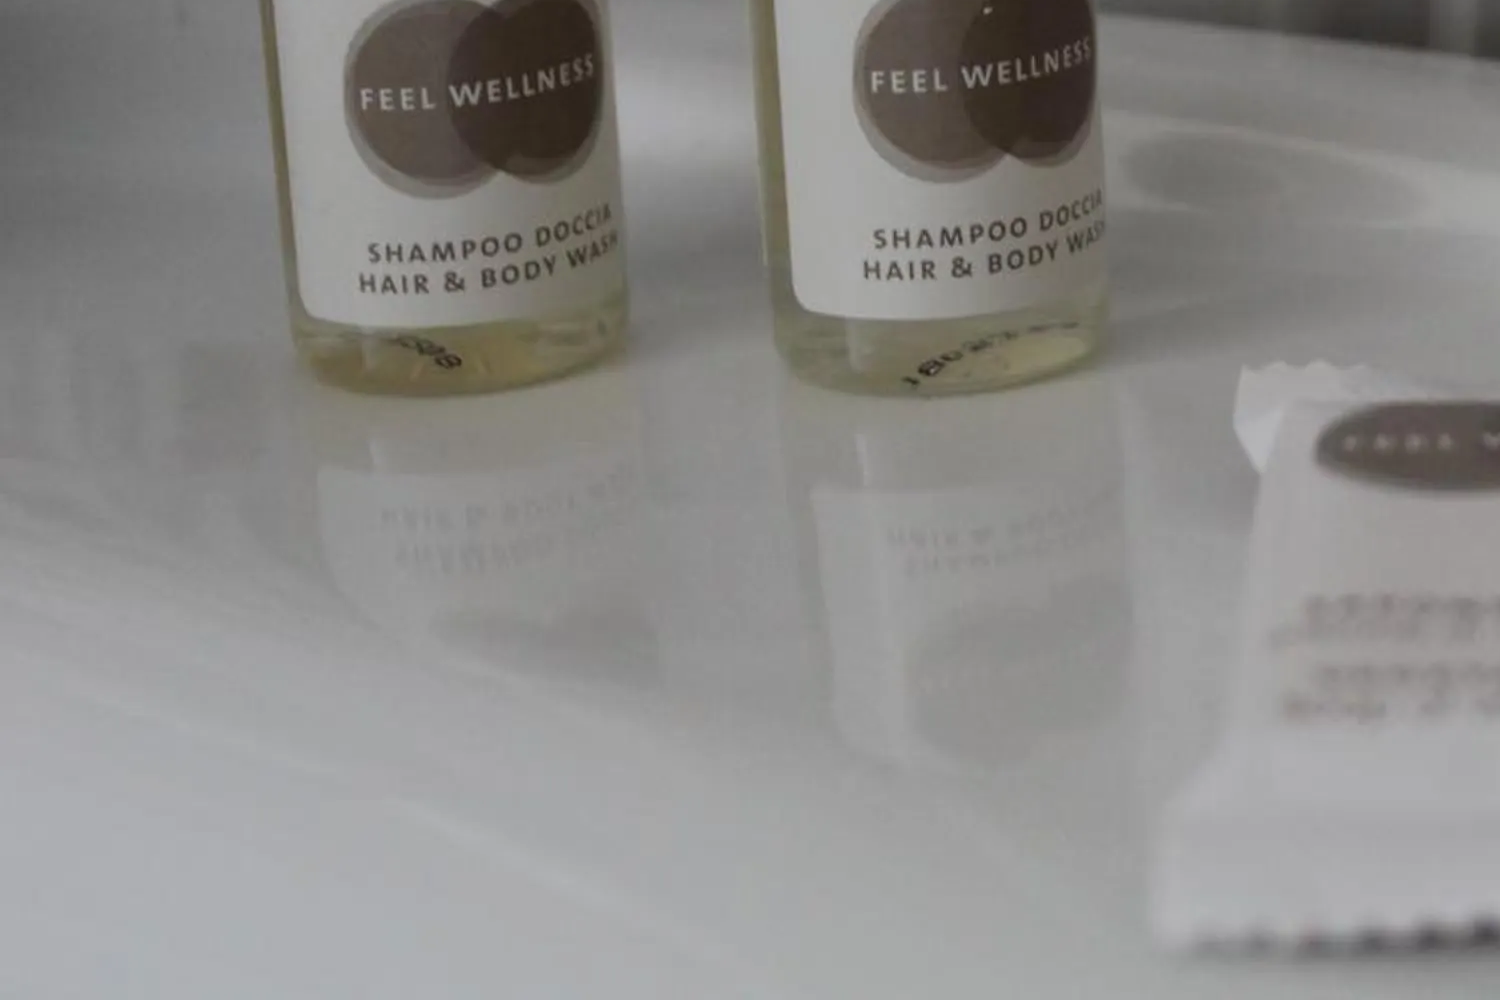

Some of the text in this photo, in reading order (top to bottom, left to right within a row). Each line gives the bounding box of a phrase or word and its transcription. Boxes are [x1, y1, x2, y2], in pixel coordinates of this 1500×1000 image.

[360, 53, 594, 111] FEEL WELLNESS
[869, 36, 1091, 94] FEEL WELLNESS
[367, 203, 611, 263] SHAMPOO DOCCIA
[873, 216, 1028, 249] SHAMPOO
[359, 272, 429, 294] HAIR
[443, 272, 465, 292] &
[481, 254, 558, 289] BODY
[863, 260, 936, 281] HAIR
[951, 257, 973, 278] &
[988, 236, 1058, 275] BODY
